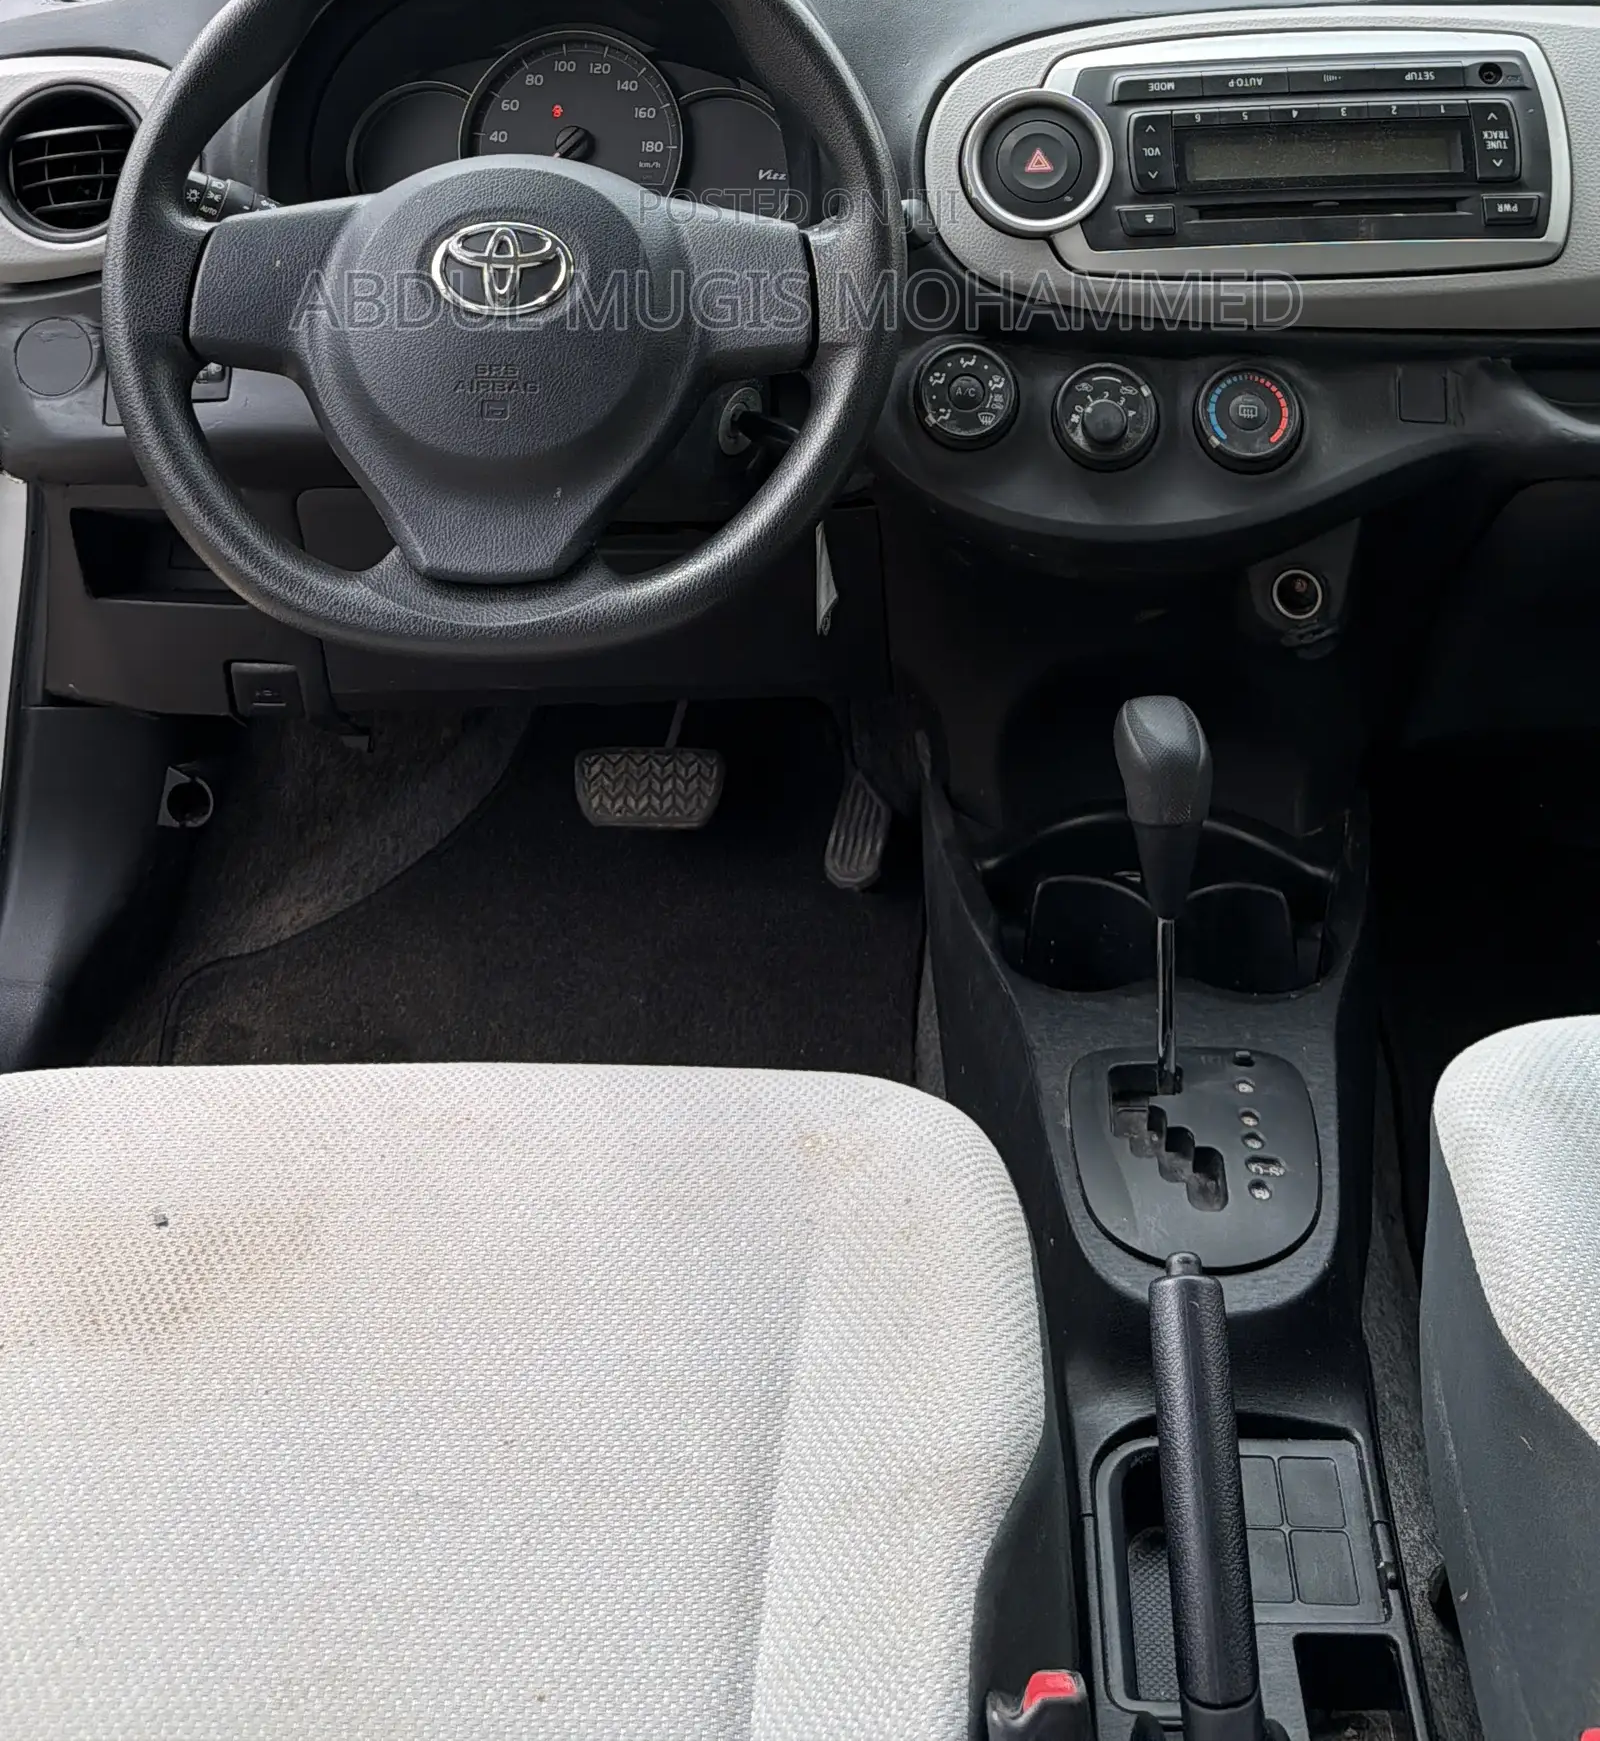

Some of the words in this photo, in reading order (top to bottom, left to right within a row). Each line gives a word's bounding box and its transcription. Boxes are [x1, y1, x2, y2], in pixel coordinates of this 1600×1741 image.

[554, 61, 576, 72] 100
[589, 63, 611, 74] 120
[525, 74, 544, 86] 80
[1405, 71, 1436, 81] SETUP
[616, 80, 639, 92] 140
[1148, 81, 1175, 92] MODE
[501, 99, 520, 111] 60
[1390, 105, 1398, 115] 2
[1439, 104, 1446, 114] 1
[634, 107, 656, 119] 160
[1241, 111, 1249, 121] 5
[1291, 109, 1299, 119] 4
[1340, 107, 1348, 117] 3
[489, 131, 508, 143] 40
[1482, 130, 1509, 140] TRACK
[641, 141, 664, 153] 180
[1486, 140, 1508, 150] TUNE
[1142, 147, 1161, 157] VOL
[638, 161, 661, 169] km/h
[200, 205, 218, 216] AUTO
[1496, 202, 1519, 213] PWR
[956, 386, 976, 397] A/C
